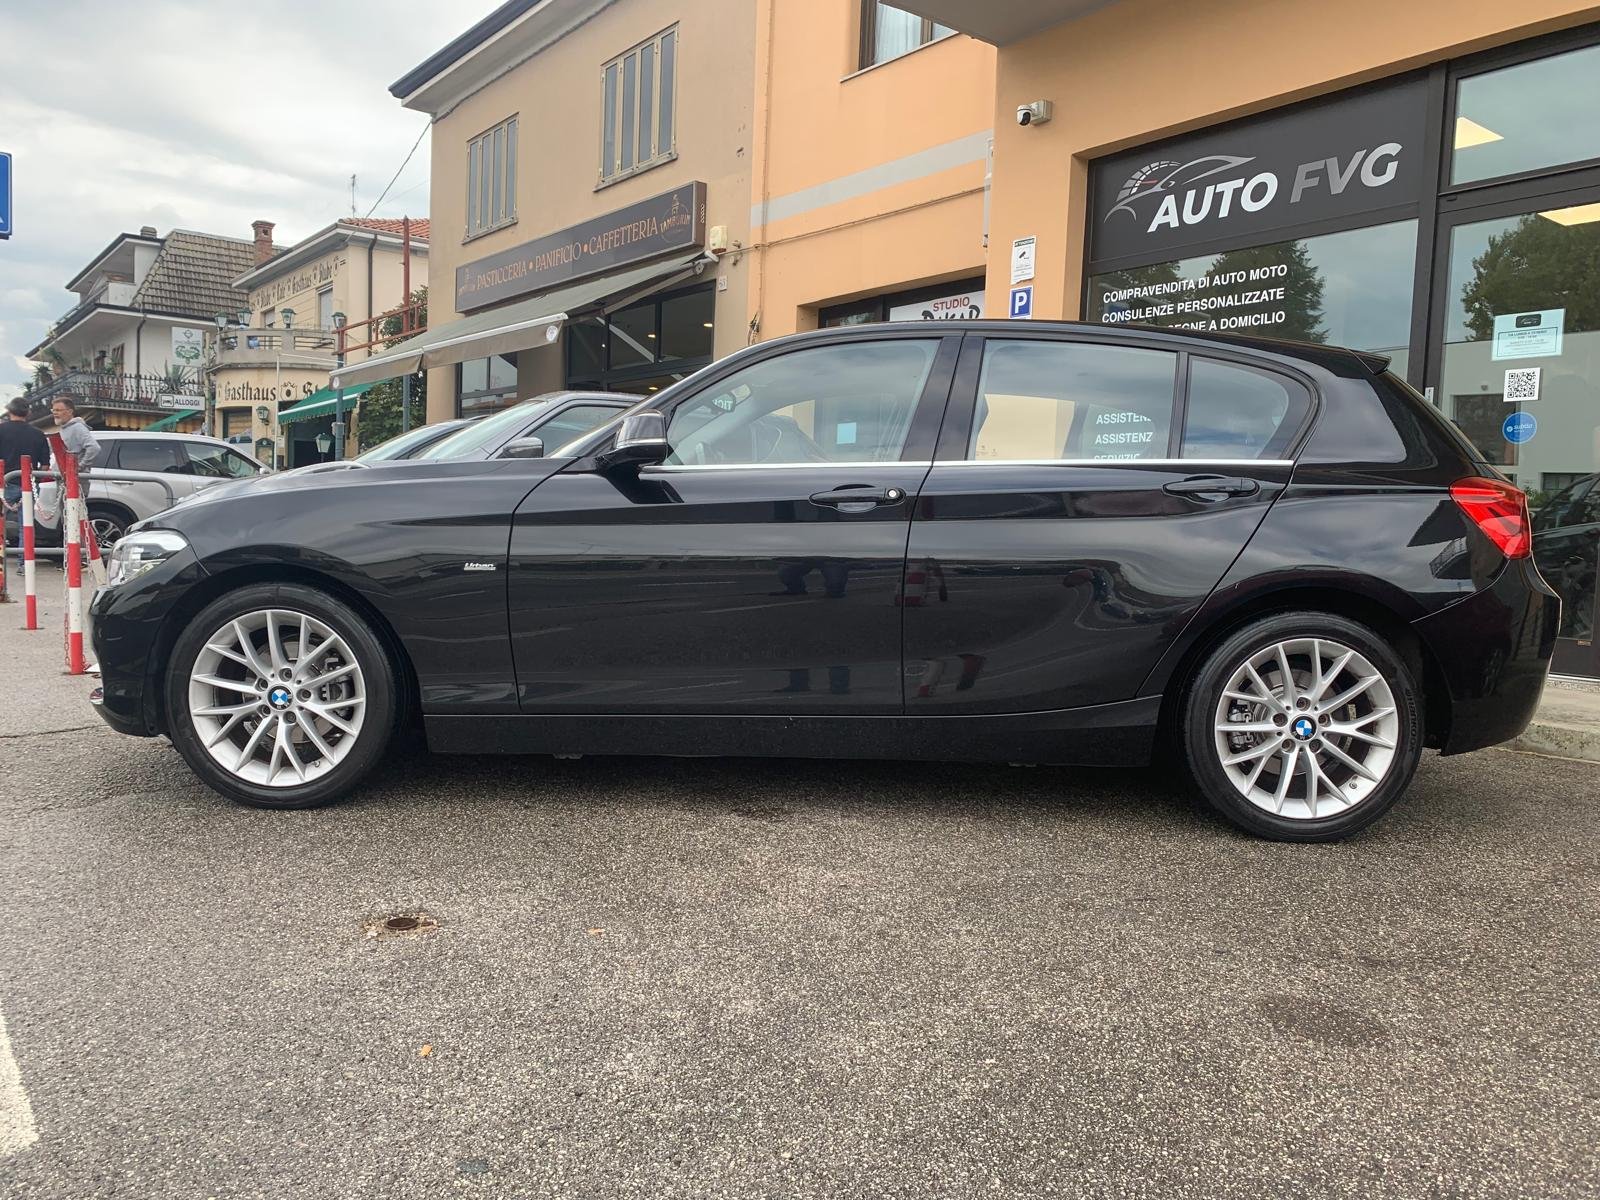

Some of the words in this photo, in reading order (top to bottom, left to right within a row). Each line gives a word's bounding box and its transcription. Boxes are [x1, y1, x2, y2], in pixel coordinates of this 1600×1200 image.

[1147, 172, 1278, 233] AUTO
[1290, 142, 1403, 204] FVG
[477, 260, 527, 291] PASTICCERIA
[535, 242, 582, 272] PANIFICIO
[588, 216, 658, 255] CAFFETTERIA
[1103, 280, 1195, 303] COMPRAVENDITA
[1198, 276, 1210, 289] DI
[1212, 270, 1246, 286] AUTO
[1249, 264, 1287, 281] MOTO
[932, 296, 970, 312] STUDIO
[1014, 291, 1028, 314] P
[1102, 304, 1174, 323] CONSULENZE
[1177, 287, 1285, 313] PERSONALIZZATE
[1208, 319, 1217, 331] A
[1220, 310, 1285, 330] DOMICILIO
[175, 396, 200, 406] ALLOGGI
[224, 380, 277, 402] Gasthaus
